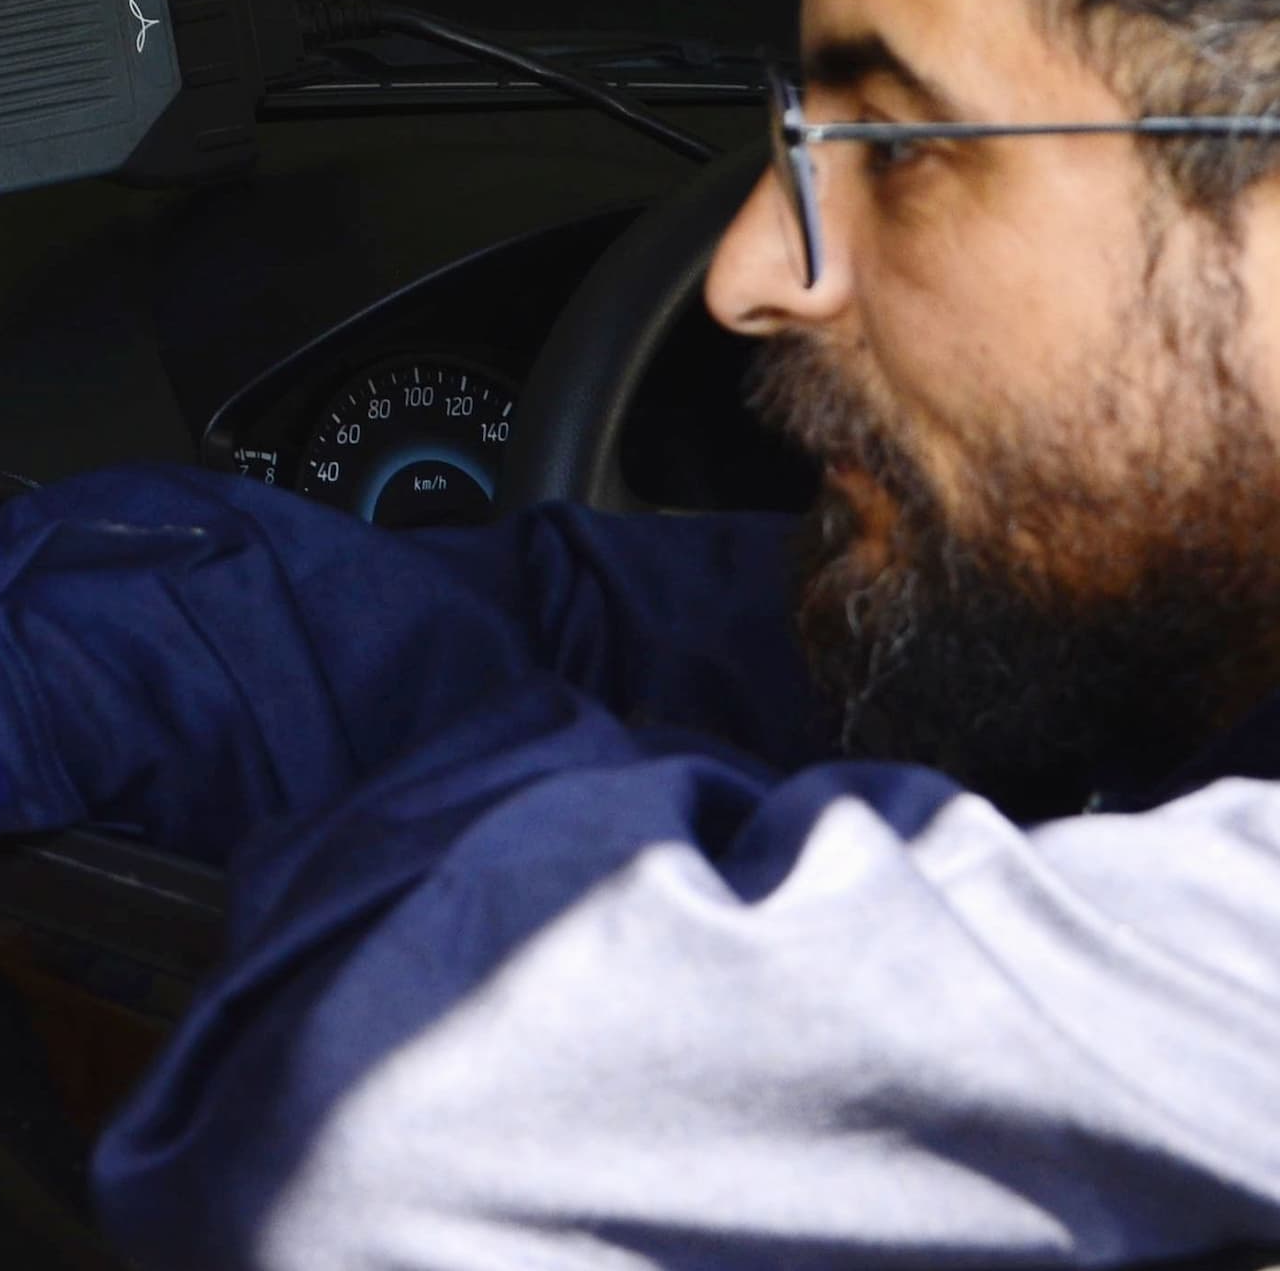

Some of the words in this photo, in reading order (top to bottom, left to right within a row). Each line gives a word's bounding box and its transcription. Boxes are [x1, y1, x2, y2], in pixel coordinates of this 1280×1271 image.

[404, 386, 434, 408] 100
[445, 396, 474, 417] 120
[367, 399, 392, 420] 80
[336, 424, 361, 446] 60
[481, 422, 510, 443] 140
[264, 467, 276, 485] 8
[317, 460, 341, 483] 40
[413, 475, 449, 492] km/h
